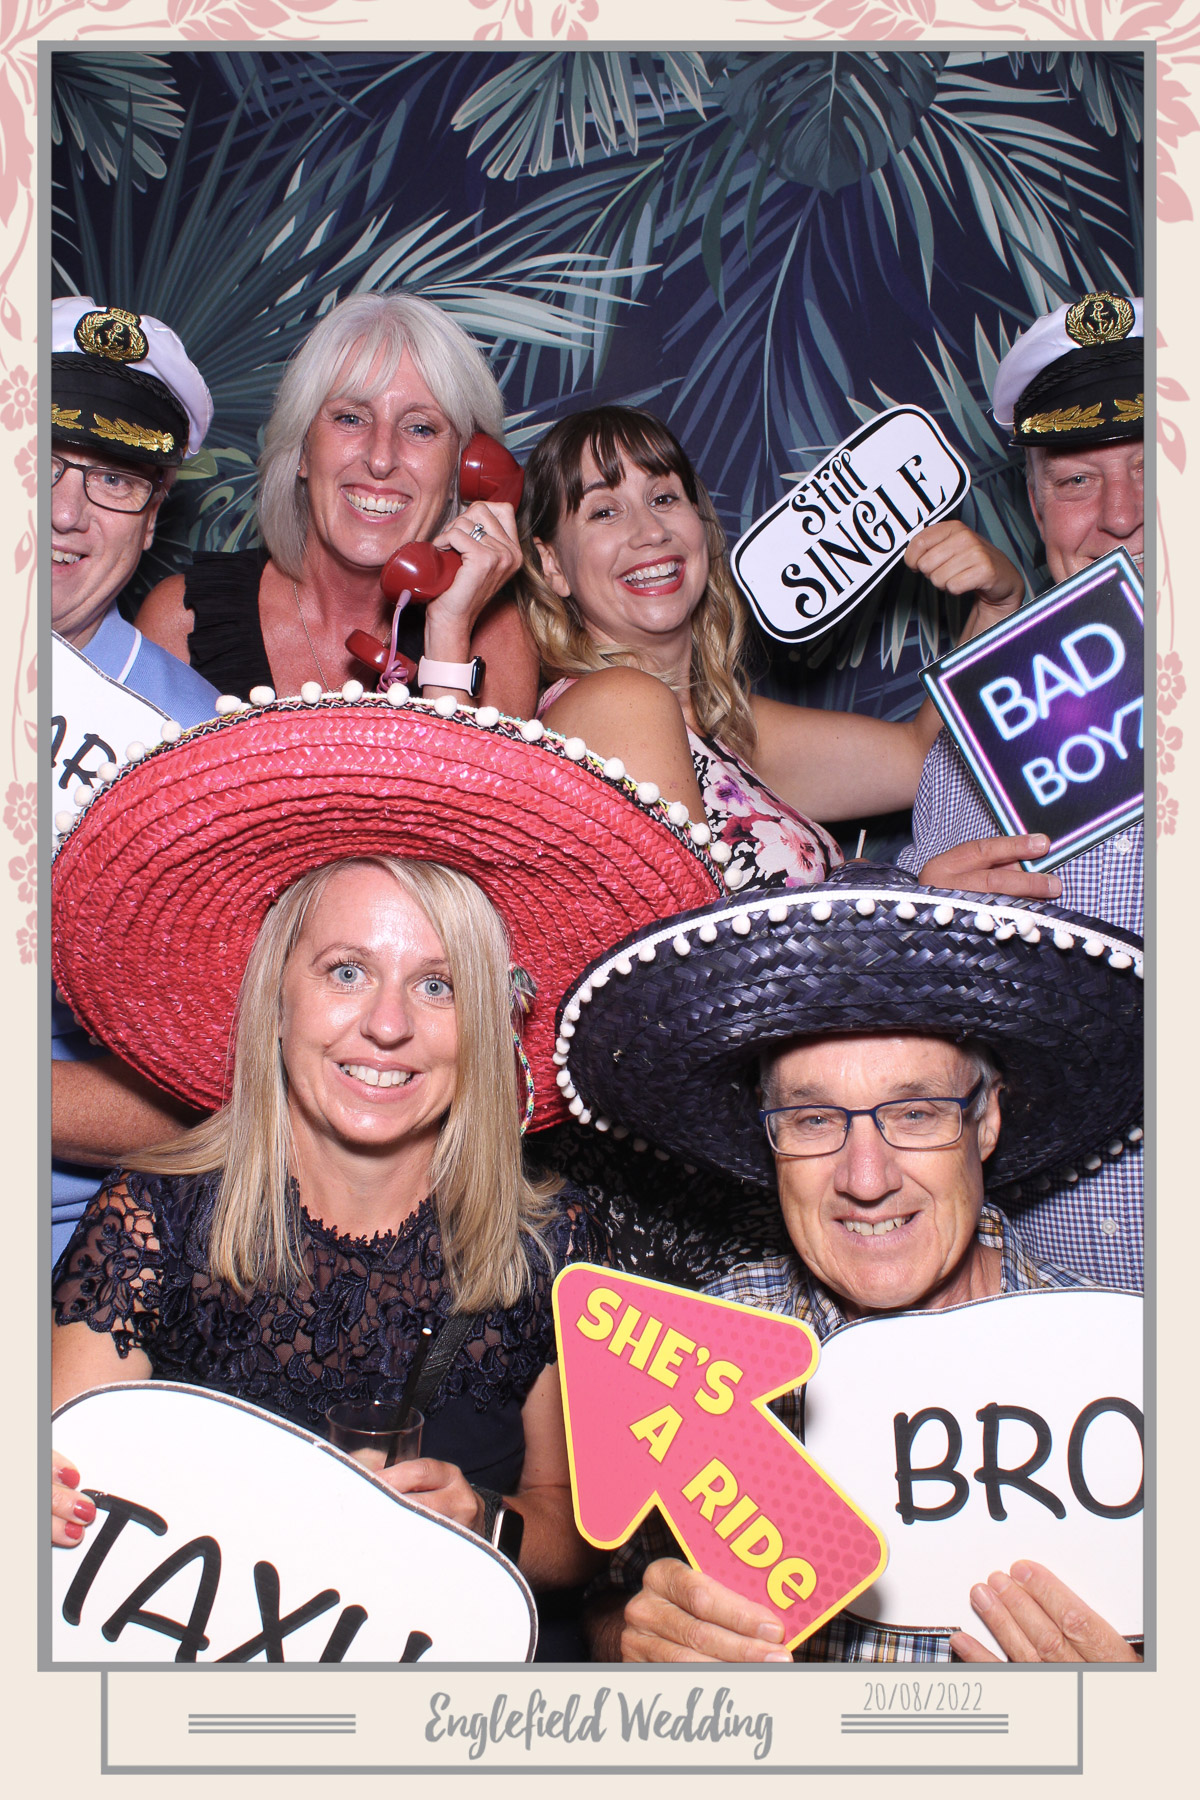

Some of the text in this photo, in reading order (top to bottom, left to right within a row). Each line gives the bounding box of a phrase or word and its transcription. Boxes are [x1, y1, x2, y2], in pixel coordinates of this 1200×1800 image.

[780, 454, 946, 619] SINGLE
[790, 448, 869, 537] Still
[979, 622, 1126, 741] BAD
[575, 1287, 745, 1415] SHE'S
[629, 1404, 684, 1464] A
[893, 1396, 1144, 1525] BRO
[62, 1488, 433, 1663] TAX
